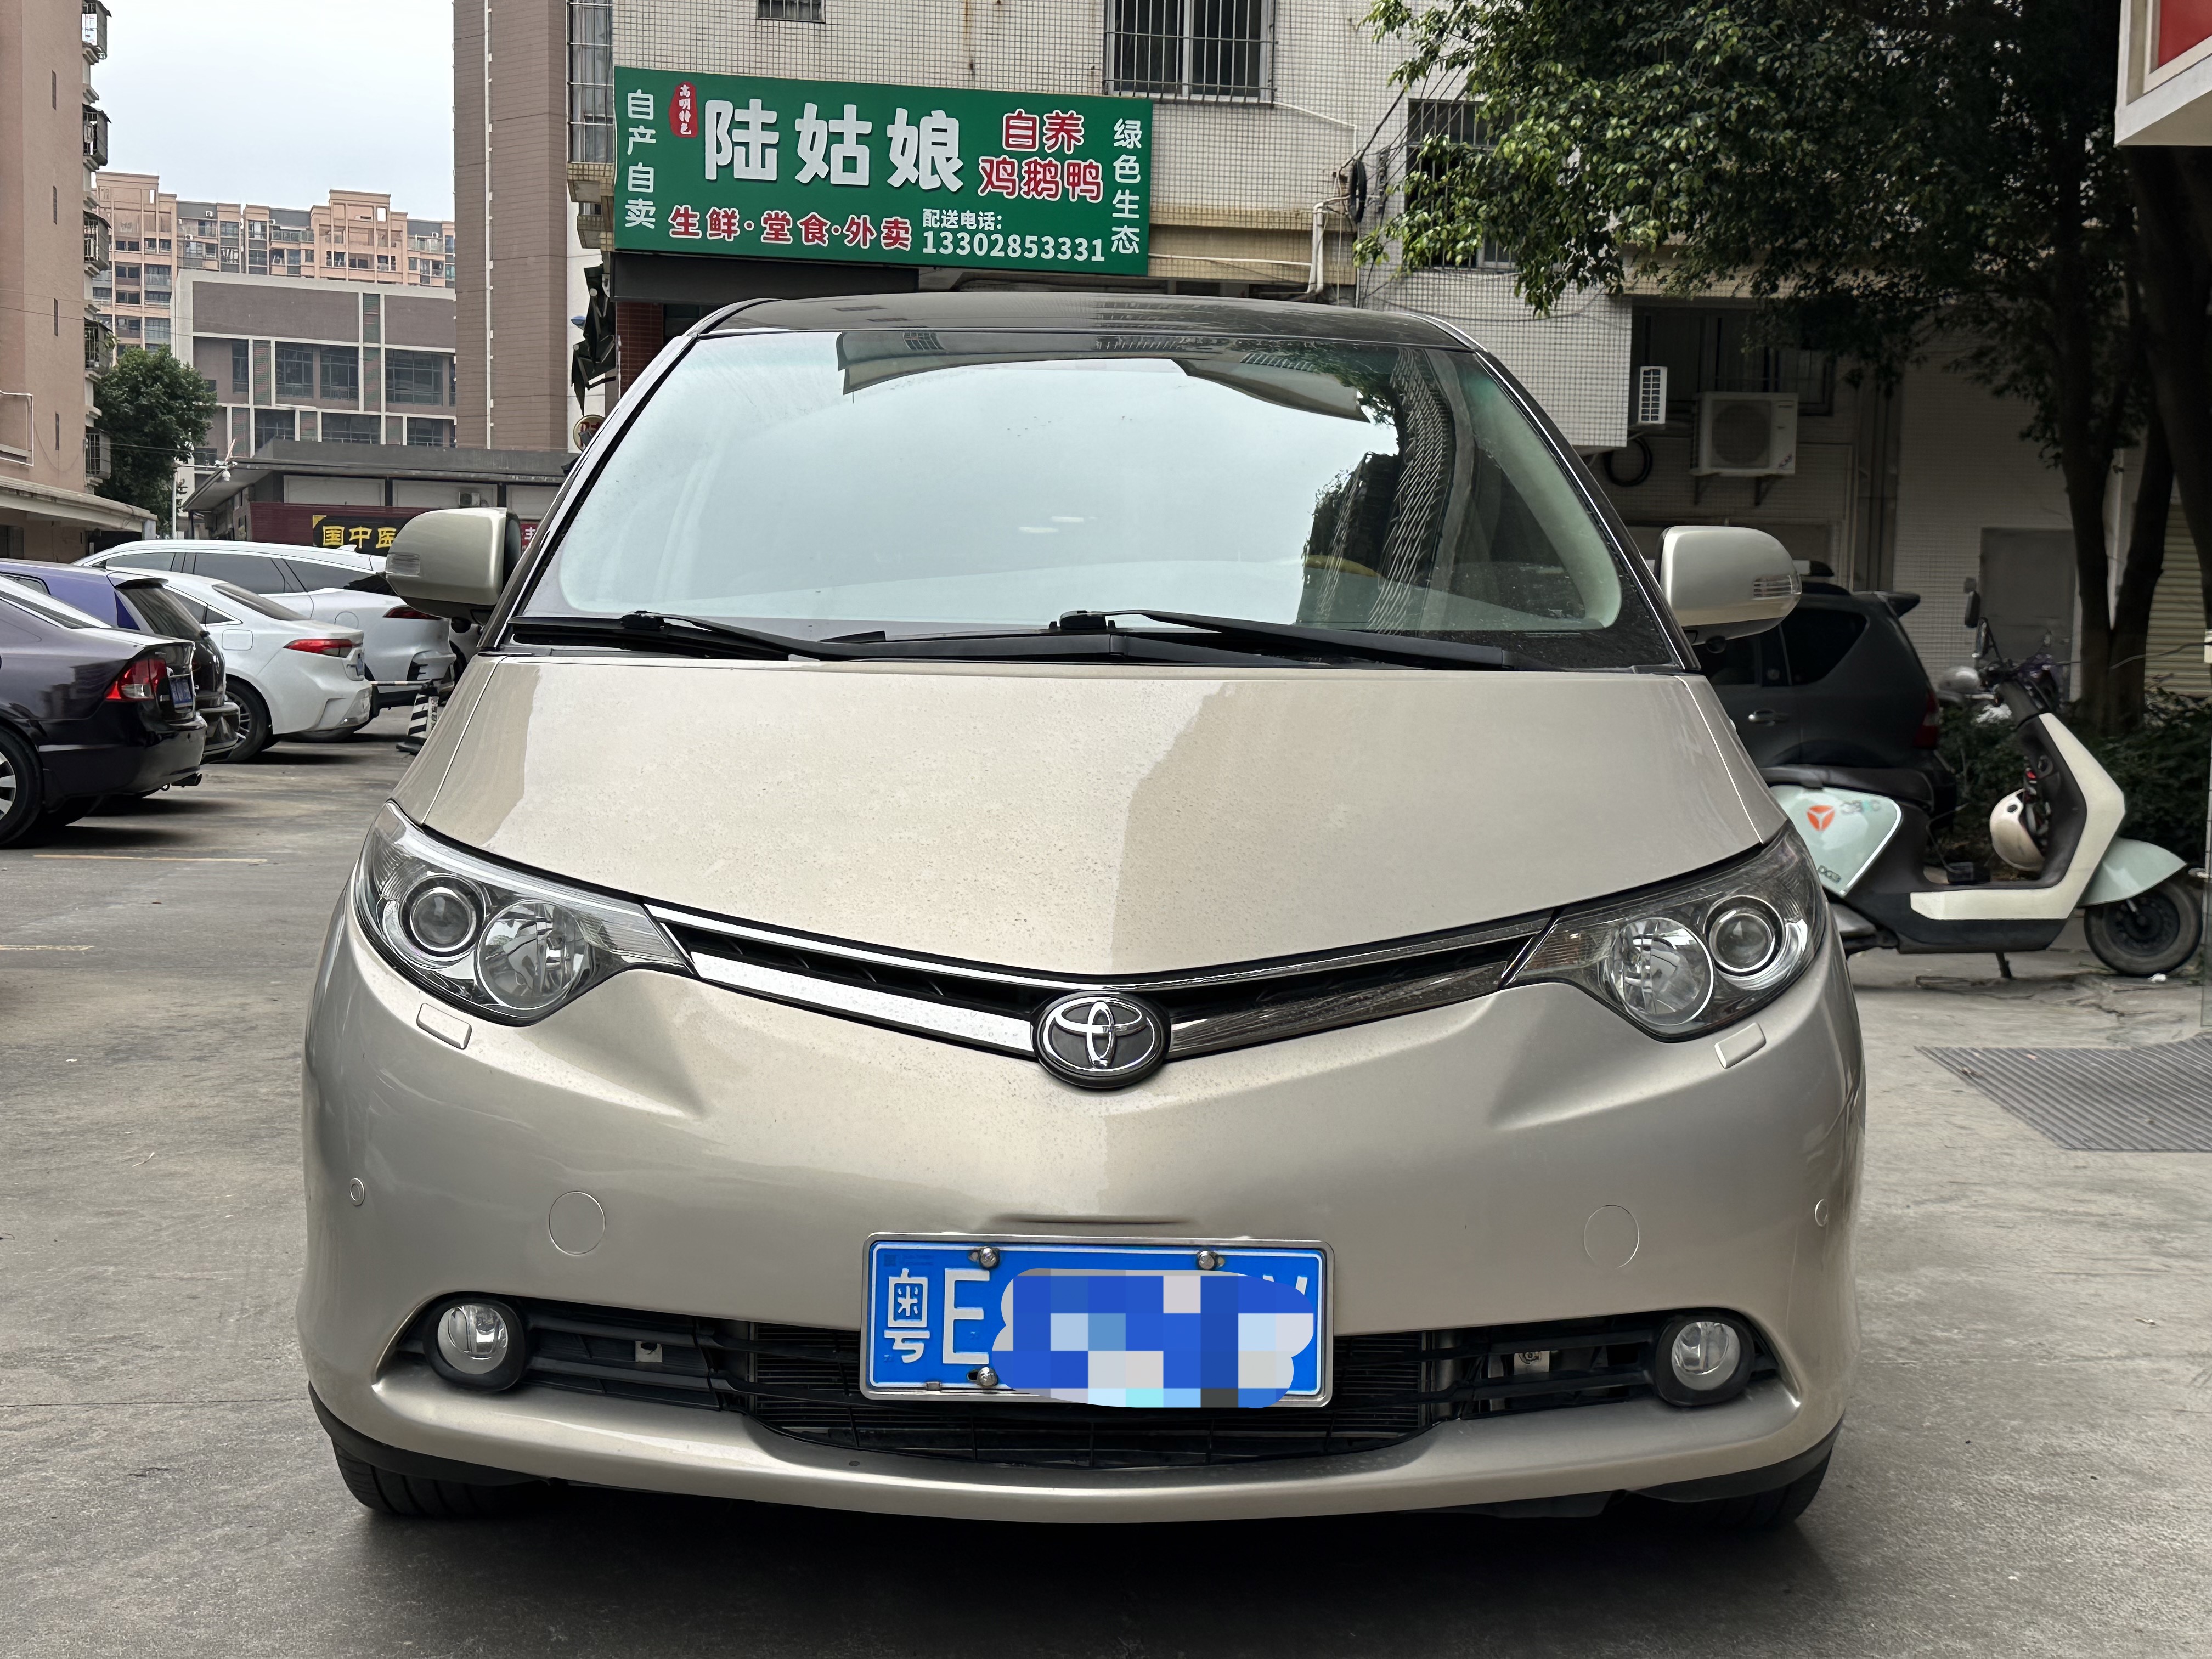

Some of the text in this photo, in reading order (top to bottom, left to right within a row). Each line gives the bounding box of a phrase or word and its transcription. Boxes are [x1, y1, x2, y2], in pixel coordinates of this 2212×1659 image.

[625, 89, 656, 229] 自产自卖
[704, 98, 964, 192] 陆姑娘
[1002, 108, 1085, 154] 自养
[977, 155, 1103, 203] 鸡鹅鸭
[1111, 118, 1142, 254] 绿色生态
[922, 230, 1105, 262] 13302853331
